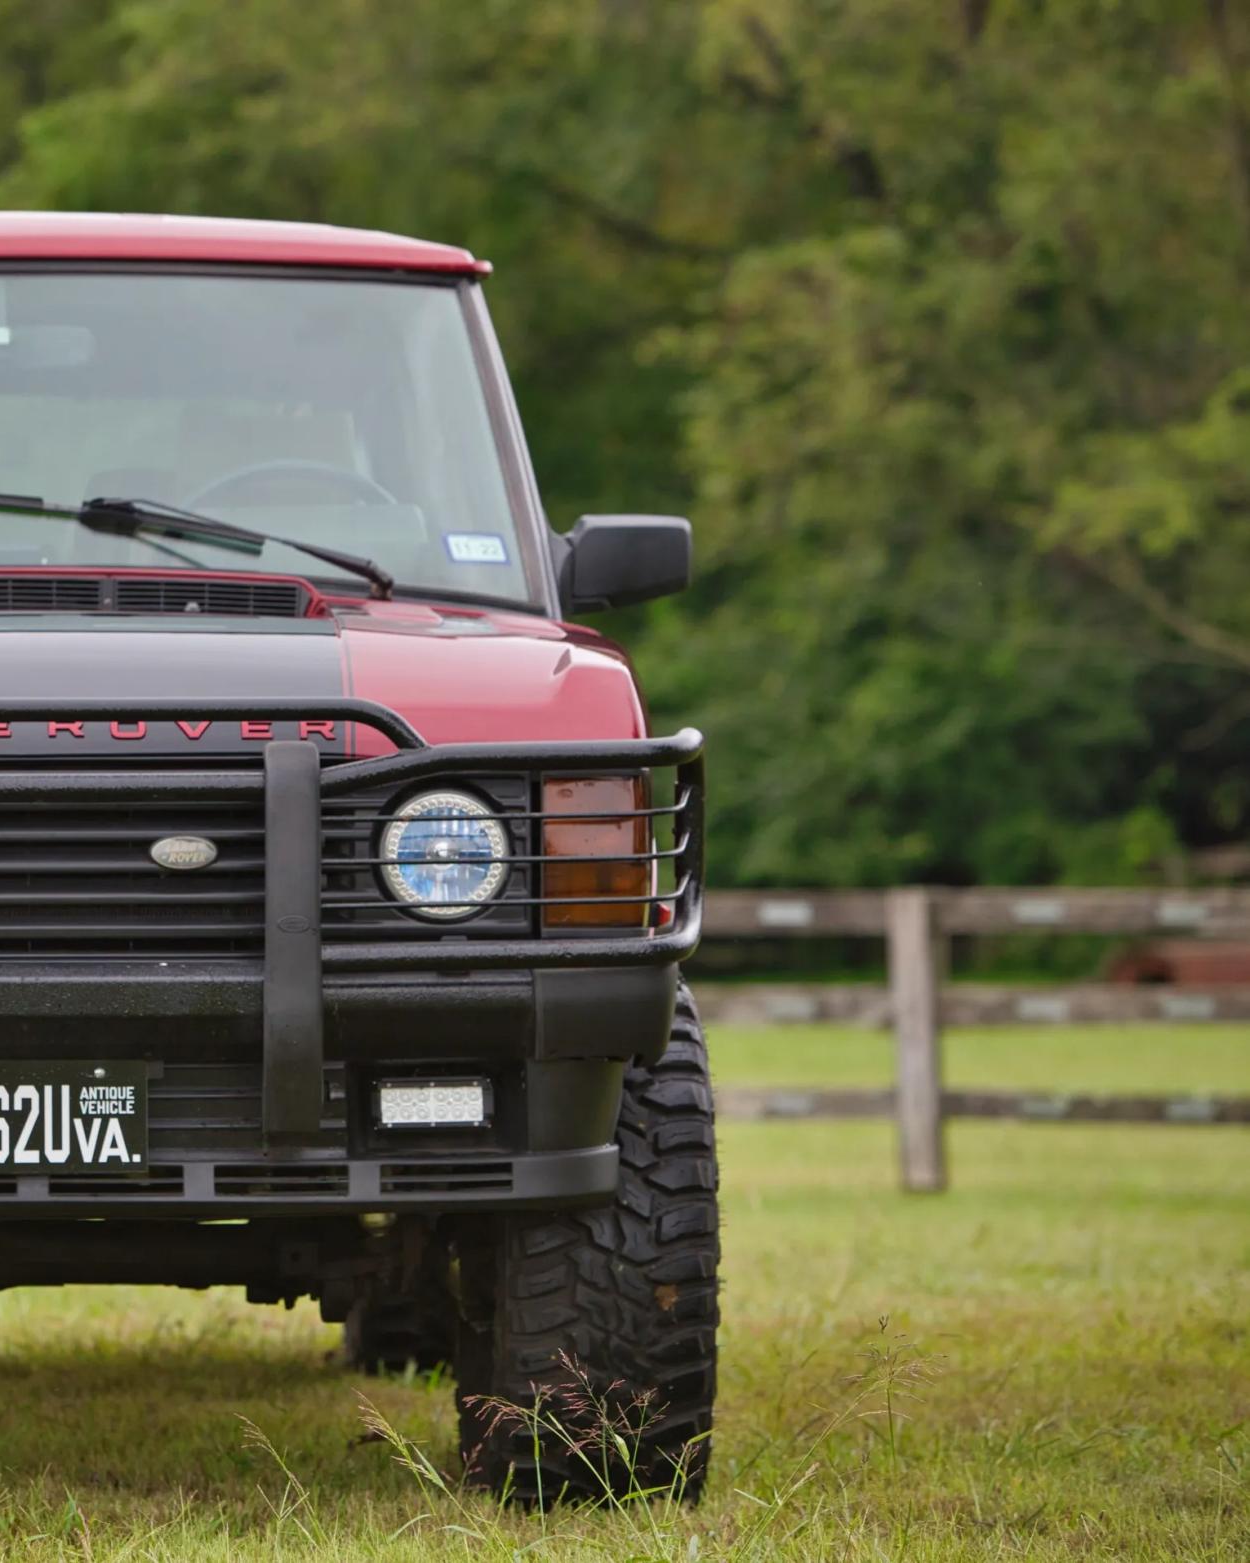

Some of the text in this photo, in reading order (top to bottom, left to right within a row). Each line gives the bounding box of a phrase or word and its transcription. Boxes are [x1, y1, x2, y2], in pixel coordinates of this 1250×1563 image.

[47, 720, 337, 740] ROVER
[79, 1086, 135, 1100] ANTIQUE
[79, 1100, 135, 1115] VEHICLE
[73, 1117, 142, 1164] VA.
